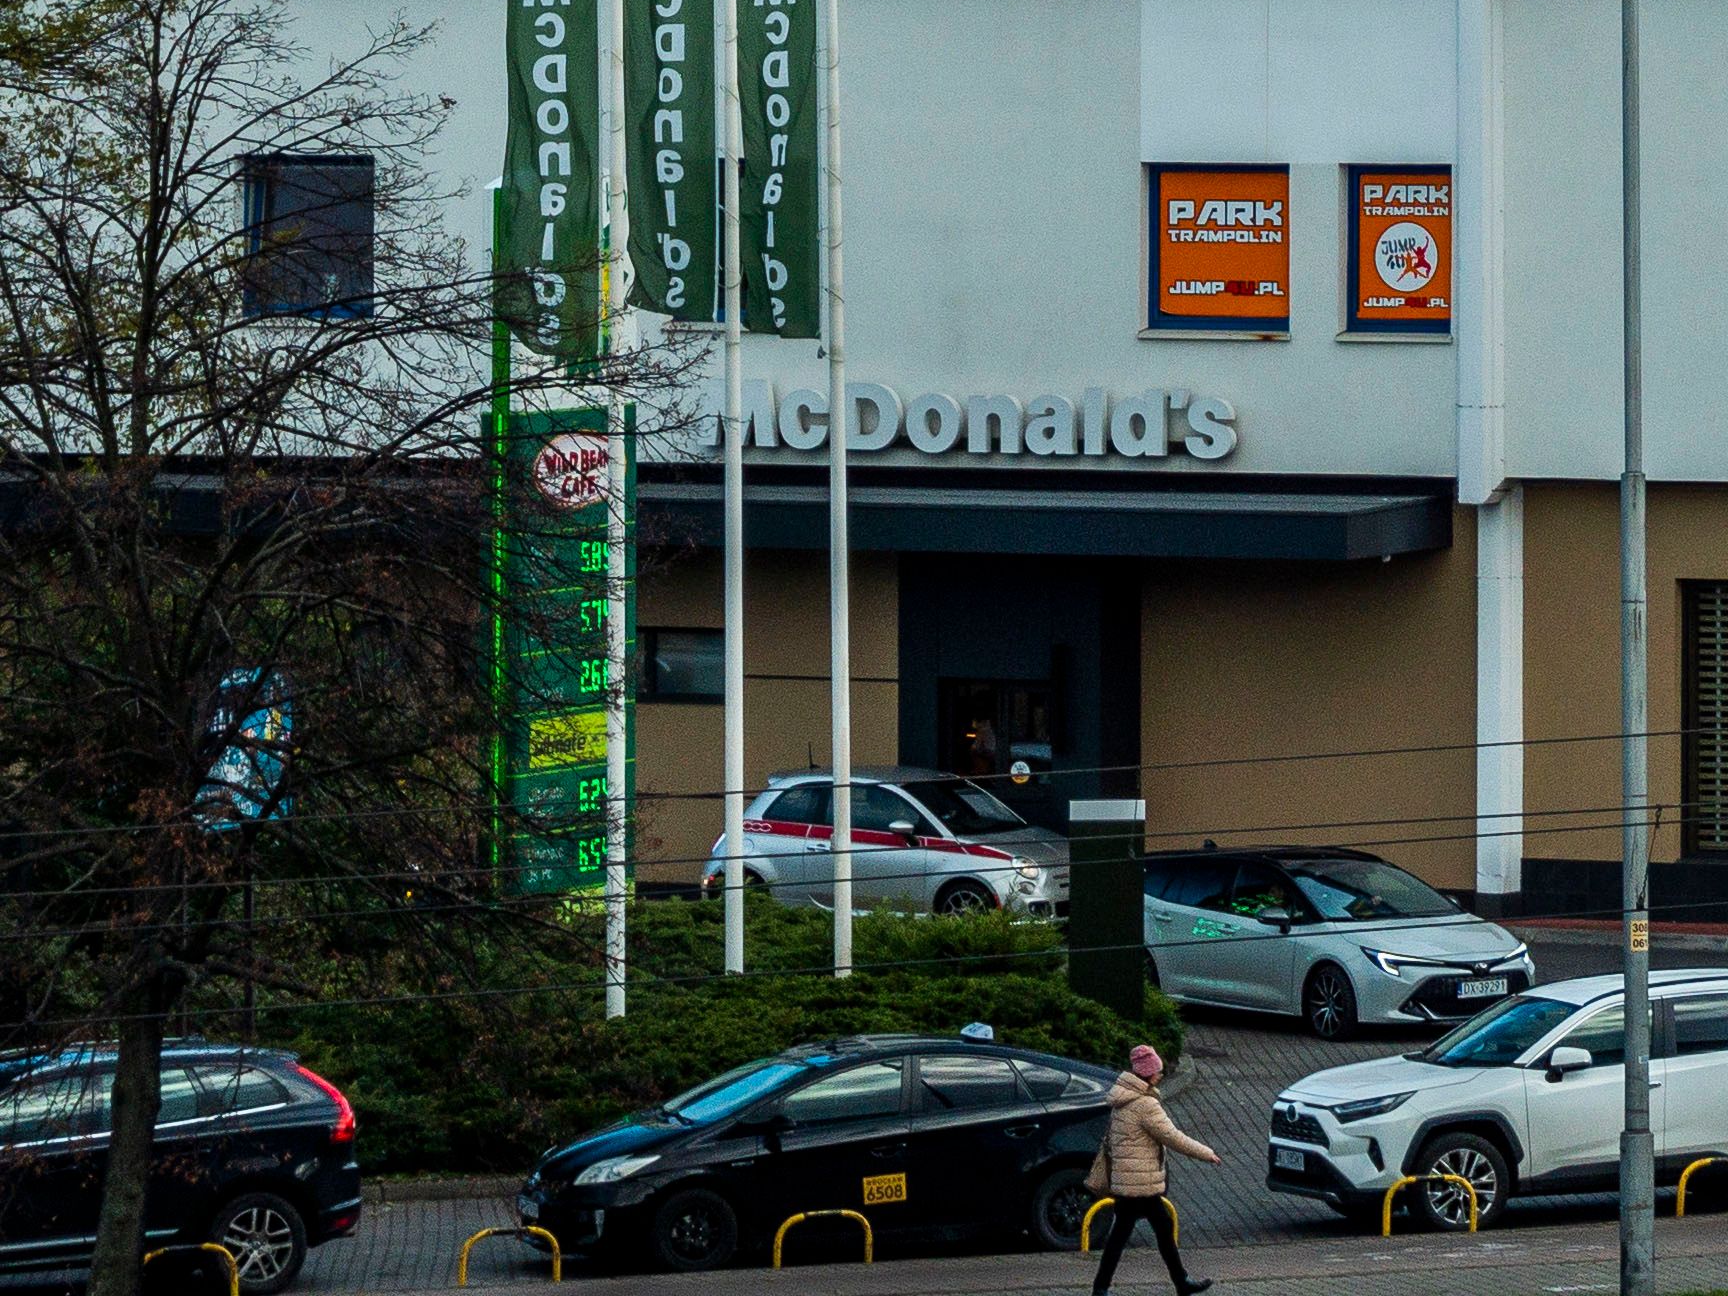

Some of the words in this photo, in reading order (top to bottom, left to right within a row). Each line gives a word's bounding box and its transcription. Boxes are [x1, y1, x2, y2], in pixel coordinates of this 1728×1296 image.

[1363, 184, 1449, 204] PARK
[1168, 200, 1282, 226] PARK
[1363, 206, 1449, 216] TRAMPOLIN
[1168, 229, 1282, 243] TRAMPOLIN
[697, 379, 1238, 458] McDonald's
[867, 1184, 902, 1202] 6508
